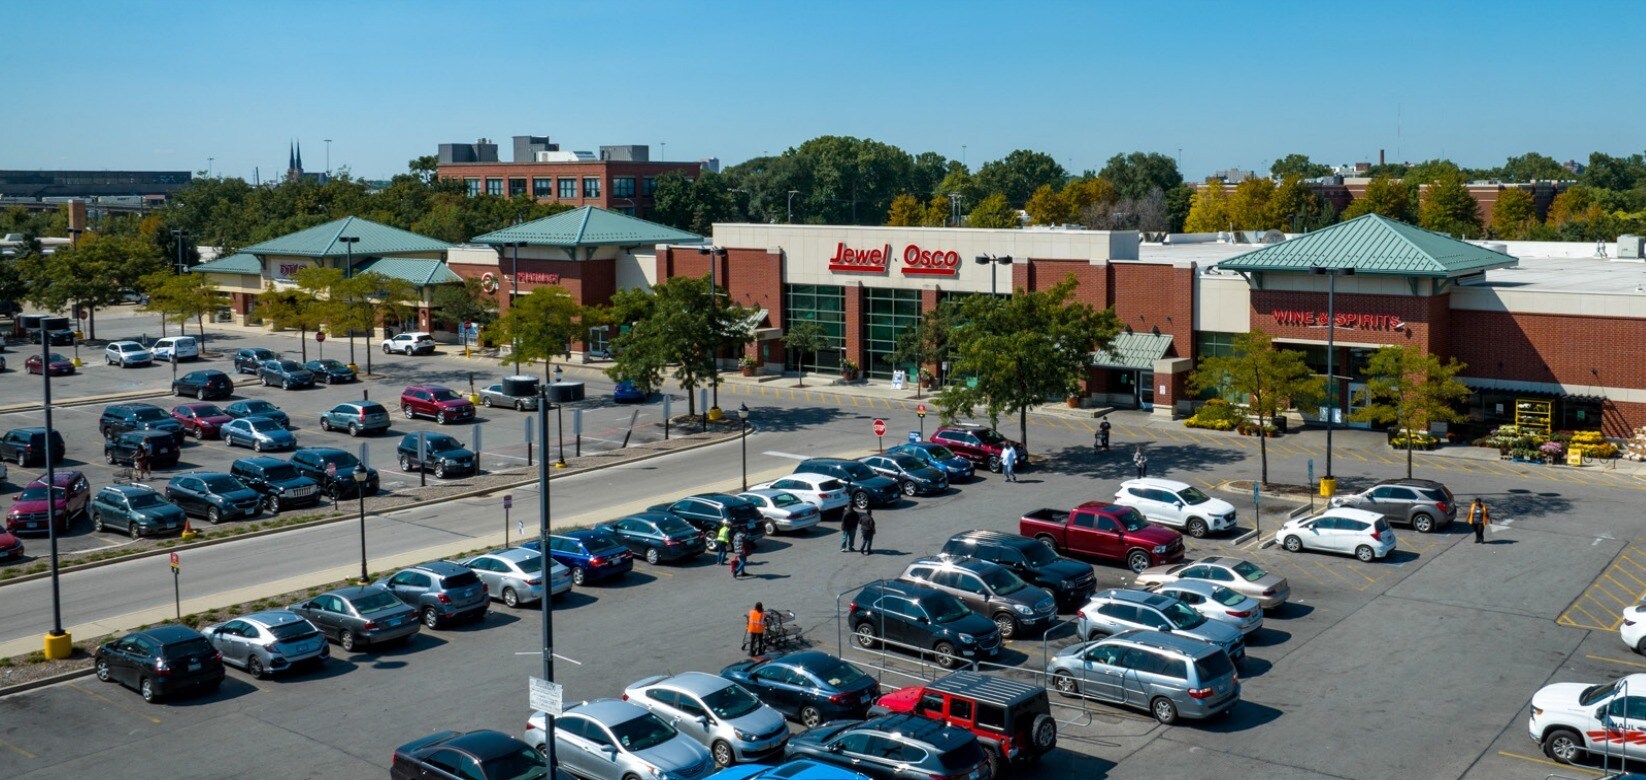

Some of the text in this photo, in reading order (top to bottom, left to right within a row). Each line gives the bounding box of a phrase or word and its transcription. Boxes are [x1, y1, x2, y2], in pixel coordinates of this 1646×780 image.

[830, 242, 958, 267] Jewel Osco
[1273, 310, 1400, 328] WINE & SPIRITS
